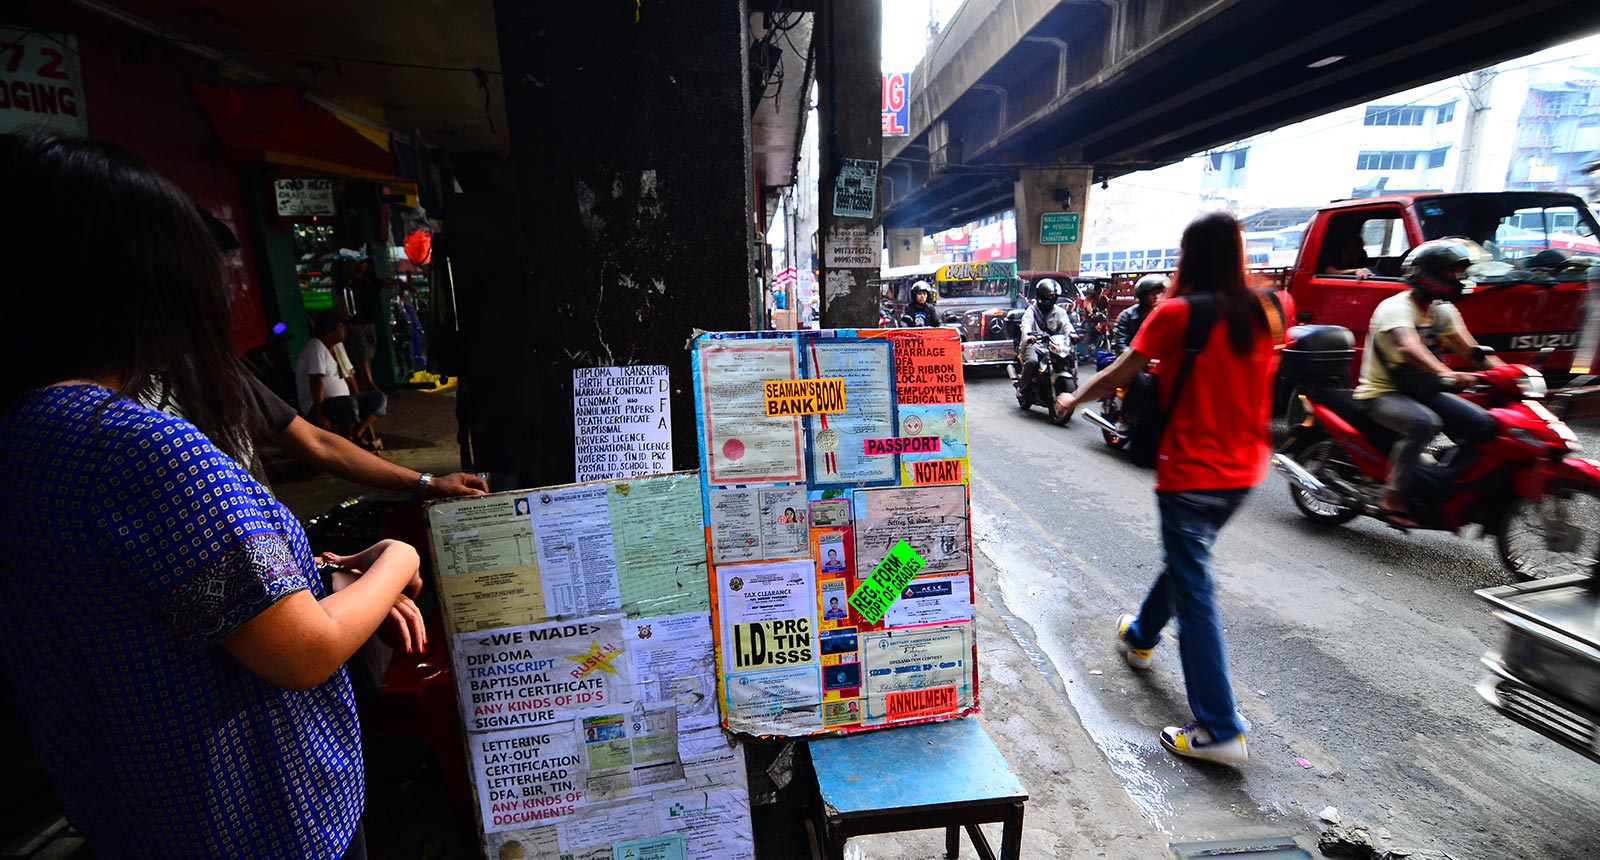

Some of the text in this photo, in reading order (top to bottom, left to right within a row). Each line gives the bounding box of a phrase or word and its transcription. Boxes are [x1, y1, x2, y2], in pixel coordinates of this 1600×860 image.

[894, 339, 924, 348] BIRTH
[1510, 334, 1577, 349] ISUZU
[895, 348, 946, 357] MARRIAGE
[895, 357, 914, 366] DFA
[896, 364, 954, 375] RED RIBBON
[575, 368, 612, 378] DIPLOMA
[896, 374, 927, 383] LOCAL
[937, 374, 957, 383] NSO
[578, 377, 655, 388] BIRTH CERTIFICATE
[897, 385, 963, 396] EMPLOYMENT
[575, 386, 654, 397] MARRIAGE CONTRACT
[766, 381, 816, 398] SEAMAN'S
[816, 380, 845, 411] BOOK
[898, 394, 963, 404] MEDICAL ETC
[578, 396, 619, 407] CENOMAR
[768, 398, 817, 415] BANK
[575, 405, 654, 416] ANNULMENT PAPERS
[577, 414, 650, 426] DEATH CERTIFICATE
[580, 425, 622, 435] BAPTISMAL
[575, 433, 645, 445] DRIVERS LICENCE
[867, 437, 939, 453] PASSPORT
[577, 442, 670, 454] INTERNATIONAL LICENCE
[578, 453, 606, 463] VOTERS
[624, 452, 637, 461] TIN
[652, 452, 667, 460] PRC
[578, 463, 606, 473] POSTAL
[620, 461, 649, 470] SCHOOL
[915, 460, 959, 483] NOTARY
[852, 554, 903, 612] REG. FORM
[865, 557, 921, 622] COPY OF GRADES
[757, 588, 791, 597] CLEARANCE
[773, 618, 809, 635] PRC
[773, 632, 810, 650] TIN
[467, 649, 533, 666] DIPLOMA
[571, 651, 606, 679] RUSH
[468, 659, 555, 679] TRANSCRIPT
[470, 673, 551, 691] BAPTISMAL
[472, 678, 603, 704] BIRTH CERTIFICATE
[474, 690, 604, 717] ANY KINDS OF ID'S
[889, 688, 954, 714] ANNULMENT
[475, 710, 555, 729] SIGNATURE
[482, 734, 551, 752] LETTERING
[484, 748, 540, 764] LAY-OUT
[485, 754, 580, 777] CERTIFICATION
[487, 769, 568, 789] LETTERHEAD
[489, 781, 576, 801] DFA, BIR, TIN,
[492, 791, 582, 813] ANY KINDS OF
[493, 804, 575, 826] DOCUMENTS
